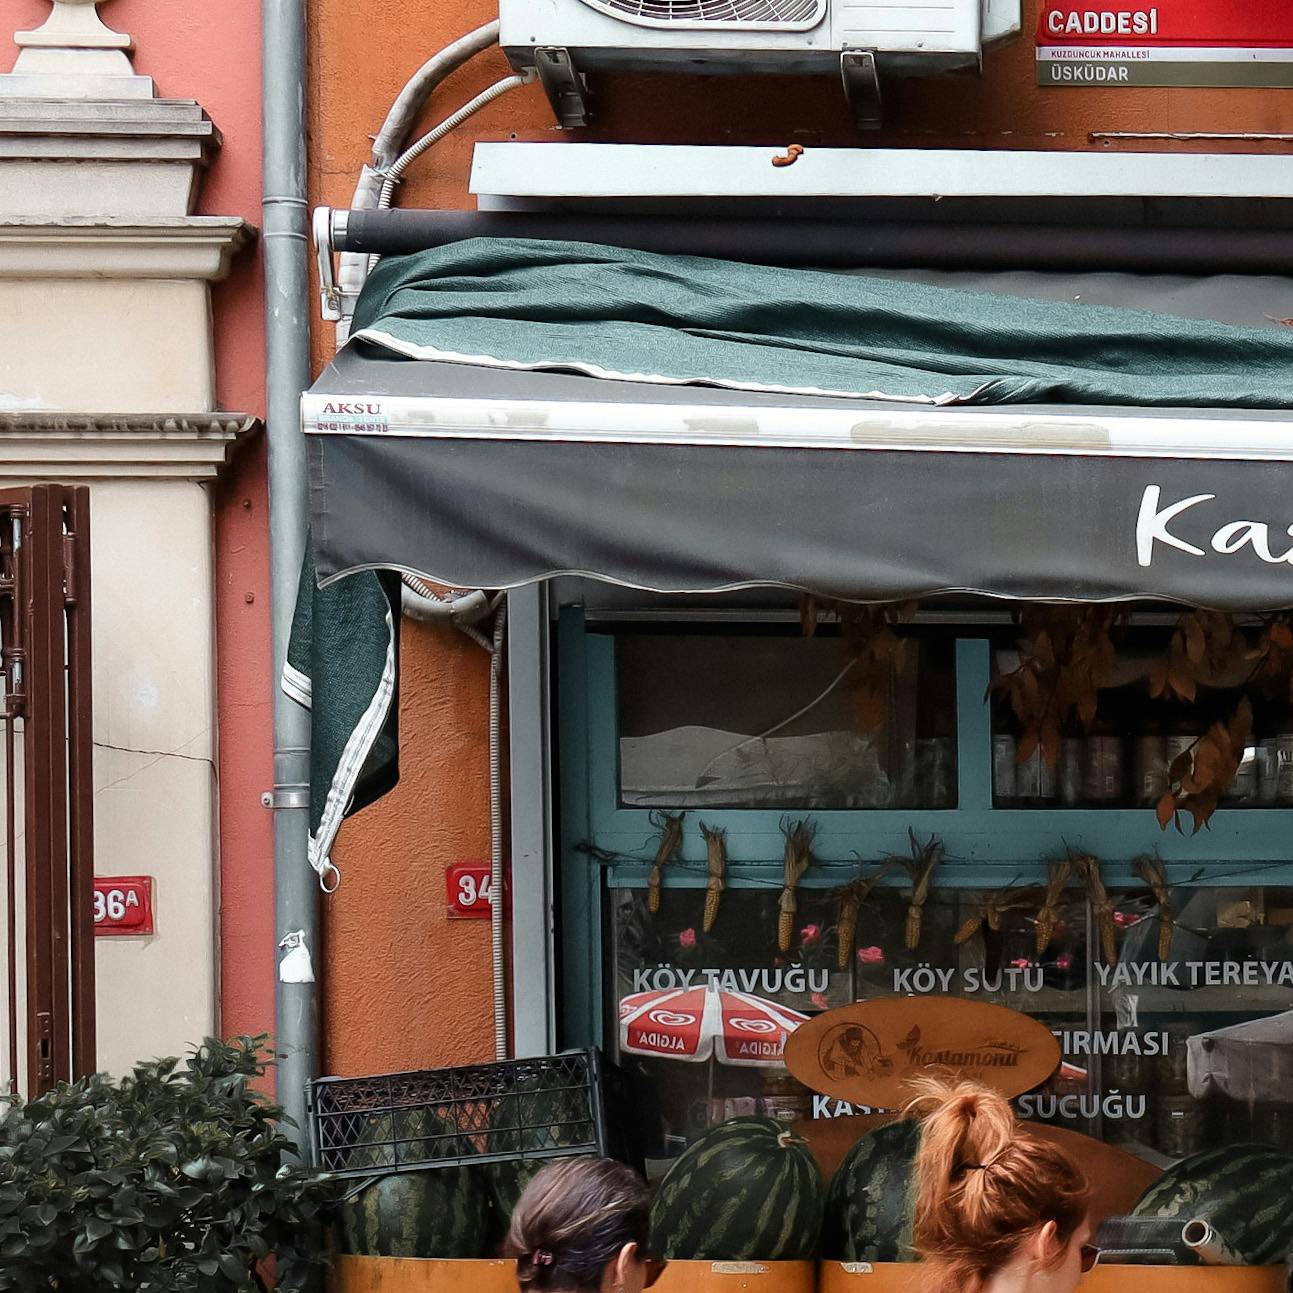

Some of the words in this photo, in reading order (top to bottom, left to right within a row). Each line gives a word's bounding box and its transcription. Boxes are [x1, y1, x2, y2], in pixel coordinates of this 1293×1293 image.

[1048, 8, 1158, 35] CADDESİ
[1051, 64, 1129, 82] ÜSKÜDAR
[322, 402, 382, 414] AKSU
[458, 875, 493, 906] 34
[633, 962, 696, 993] KÖY
[701, 962, 829, 993] TAVUĞU
[893, 962, 955, 992] KÖY
[1094, 960, 1181, 987] YAYIK
[1017, 1089, 1146, 1119] SUCUĞU
